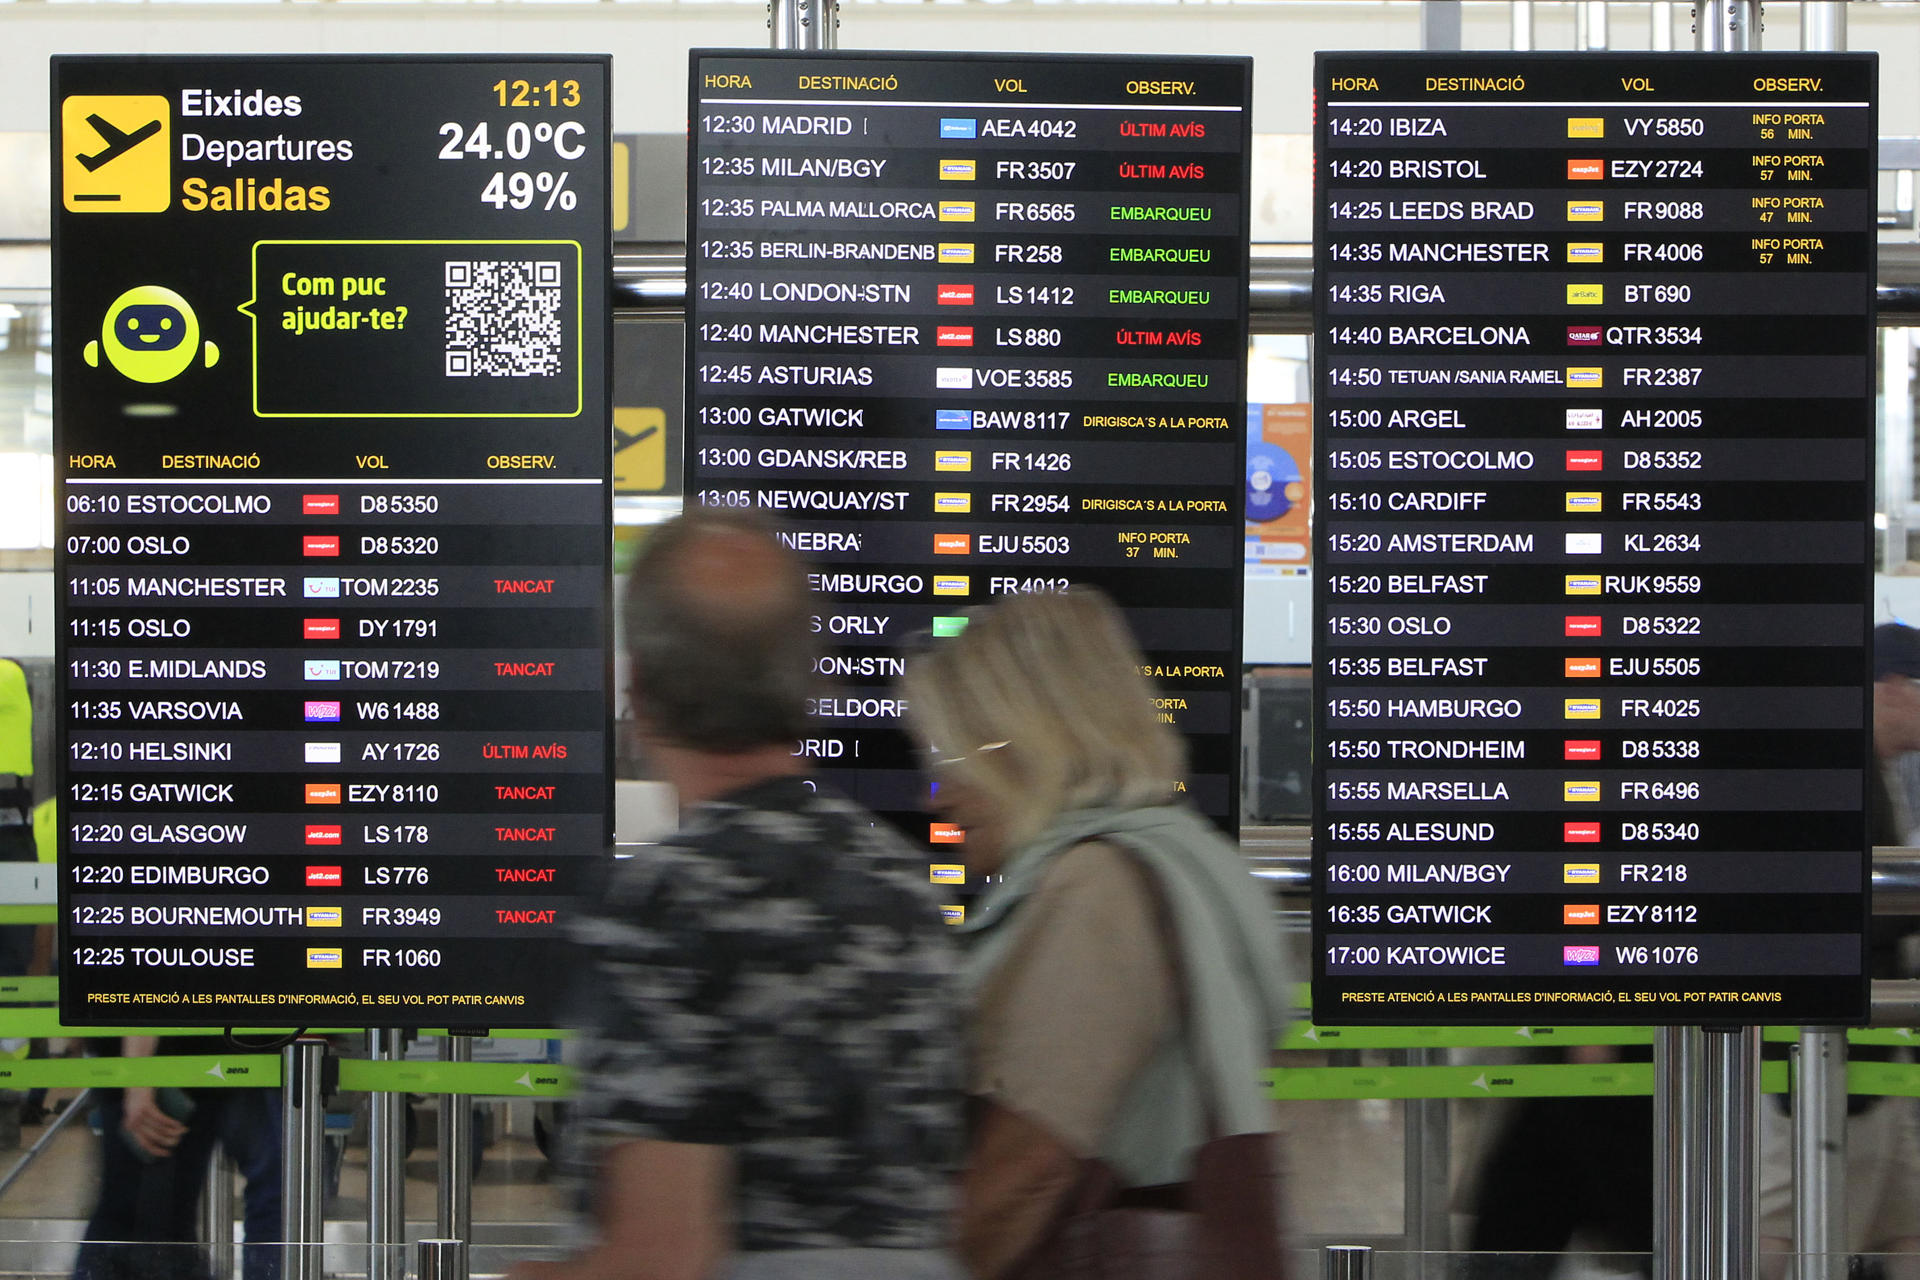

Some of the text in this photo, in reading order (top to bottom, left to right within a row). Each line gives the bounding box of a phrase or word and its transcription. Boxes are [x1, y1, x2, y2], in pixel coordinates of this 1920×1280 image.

[704, 74, 753, 89] HORA
[798, 73, 898, 91] DESTINACIÓ
[994, 78, 1028, 93] VOL
[1126, 80, 1197, 95] OBSERV.
[1331, 77, 1380, 91] HORA
[1425, 74, 1525, 91] DESTINACIÓ
[1621, 77, 1655, 92] VOL
[1753, 77, 1824, 92] OBSERV.
[182, 89, 302, 116] Eixides
[493, 80, 581, 107] 12:13
[703, 115, 853, 136] 12:30 MADRID
[1120, 120, 1206, 138] ÚLTIM AVÍS
[1330, 118, 1447, 136] 14:20 IBIZA
[182, 134, 353, 167] Departures
[702, 157, 886, 178] 12:35 MILAN/BGY
[1390, 160, 1486, 178] BRISTOL
[182, 178, 331, 211] Salidas
[481, 172, 577, 211] 49%
[761, 200, 935, 219] PALMA MALLORCA
[1330, 202, 1534, 220] 14:25 LEEDS BRAD
[1752, 197, 1825, 209] INFO PORTA
[1111, 207, 1211, 221] EMBARQUEU
[1760, 212, 1813, 224] 47 MIN.
[760, 242, 935, 261] BERLIN-BRANDENB
[1110, 248, 1210, 262] EMBARQUEU
[1330, 244, 1549, 261] 14:35 MANCHESTER
[282, 273, 386, 301] Com puc
[760, 284, 911, 303] LONDON-STN
[940, 291, 972, 299] Jet2.com
[1390, 285, 1445, 303] RIGA
[282, 305, 408, 336] ajudar-te?
[760, 325, 919, 344] MANCHESTER
[939, 333, 971, 341] Jet2.com
[1116, 329, 1202, 346] ÚLTIM AVÍS
[1330, 327, 1530, 345] 14:40 BARCELONA
[758, 366, 873, 386] ASTURIAS
[1388, 369, 1563, 384] TETUAN /SANIA RAMEL
[699, 407, 864, 427] 13:00 GATWICK
[1329, 410, 1466, 428] 15:00 ARGEL
[69, 454, 117, 469] HORA
[162, 452, 261, 469] DESTINACIÓ
[355, 455, 389, 469] VOL
[486, 455, 557, 469] OBSERV.
[758, 449, 907, 469] GDANSK/REB
[1389, 451, 1534, 469] ESTOCOLMO
[67, 495, 271, 513] 06:10 ESTOCOLMO
[758, 490, 909, 511] NEWQUAY/ST
[1388, 493, 1486, 510] CARDIFF
[67, 536, 189, 554] 07:00 OSLO
[1118, 532, 1191, 544] INFO PORTA
[1387, 534, 1533, 552] AMSTERDAM
[1125, 547, 1179, 559] 37 MIN.
[70, 578, 286, 596] 11:05 MANCHESTER
[493, 579, 556, 594] TANCAT
[808, 574, 924, 593] EMBURGO
[1329, 575, 1488, 593] 15:20 BELFAST
[128, 619, 190, 637] OSLO
[829, 616, 890, 634] ORLY
[1388, 617, 1451, 635] OSLO
[71, 660, 266, 679] 11:30 E.MIDLANDS
[493, 662, 556, 677] TANCAT
[1154, 666, 1225, 678] A LA PORTA
[1388, 658, 1488, 676] BELFAST
[72, 702, 243, 720] 11:35 VARSOVIA
[1388, 700, 1521, 718] HAMBURGO
[71, 742, 231, 760] 12:10 HELSINKI
[483, 743, 567, 758] ÚLTIM AVÍS
[1387, 741, 1524, 758] TRONDHEIM
[130, 784, 233, 802] GATWICK
[494, 786, 556, 800] TANCAT
[1328, 782, 1509, 800] 15:55 MARSELLA
[130, 825, 246, 843] GLASGOW
[308, 831, 340, 839] Jet2.com
[494, 827, 557, 842] TANCAT
[1387, 823, 1494, 841] ALESUND
[72, 866, 269, 884] 12:20 EDIMBURGO
[308, 872, 340, 880] Jet2.com
[1328, 865, 1511, 883] 16:00 MILAN/BGY
[131, 907, 302, 925] BOURNEMOUTH
[495, 909, 557, 924] TANCAT
[1387, 906, 1491, 923] GATWICK
[73, 948, 254, 966] 12:25 TOULOUSE
[1328, 947, 1505, 964] 17:00 KATOWICE
[87, 993, 131, 1004] PRESTE
[132, 991, 180, 1004] ATENCIÓ
[181, 993, 190, 1004] A
[192, 993, 213, 1004] LES
[215, 993, 276, 1004] PANTALLES
[361, 994, 376, 1005] EL
[377, 994, 400, 1005] SEU
[402, 994, 425, 1005] VOL
[426, 994, 450, 1005] POT
[451, 994, 483, 1005] PATIR
[484, 995, 525, 1006] CANVIS
[1341, 992, 1386, 1003] PRESTE
[1387, 990, 1435, 1003] ATENCIÓ
[1436, 992, 1446, 1002] A
[1447, 992, 1469, 1003] LES
[1470, 992, 1532, 1003] PANTALLES
[1618, 992, 1632, 1002] EL
[1634, 992, 1657, 1002] SEU
[1658, 992, 1682, 1002] VOL
[1683, 992, 1707, 1002] POT
[1708, 991, 1739, 1002] PATIR
[1741, 992, 1782, 1002] CANVIS
